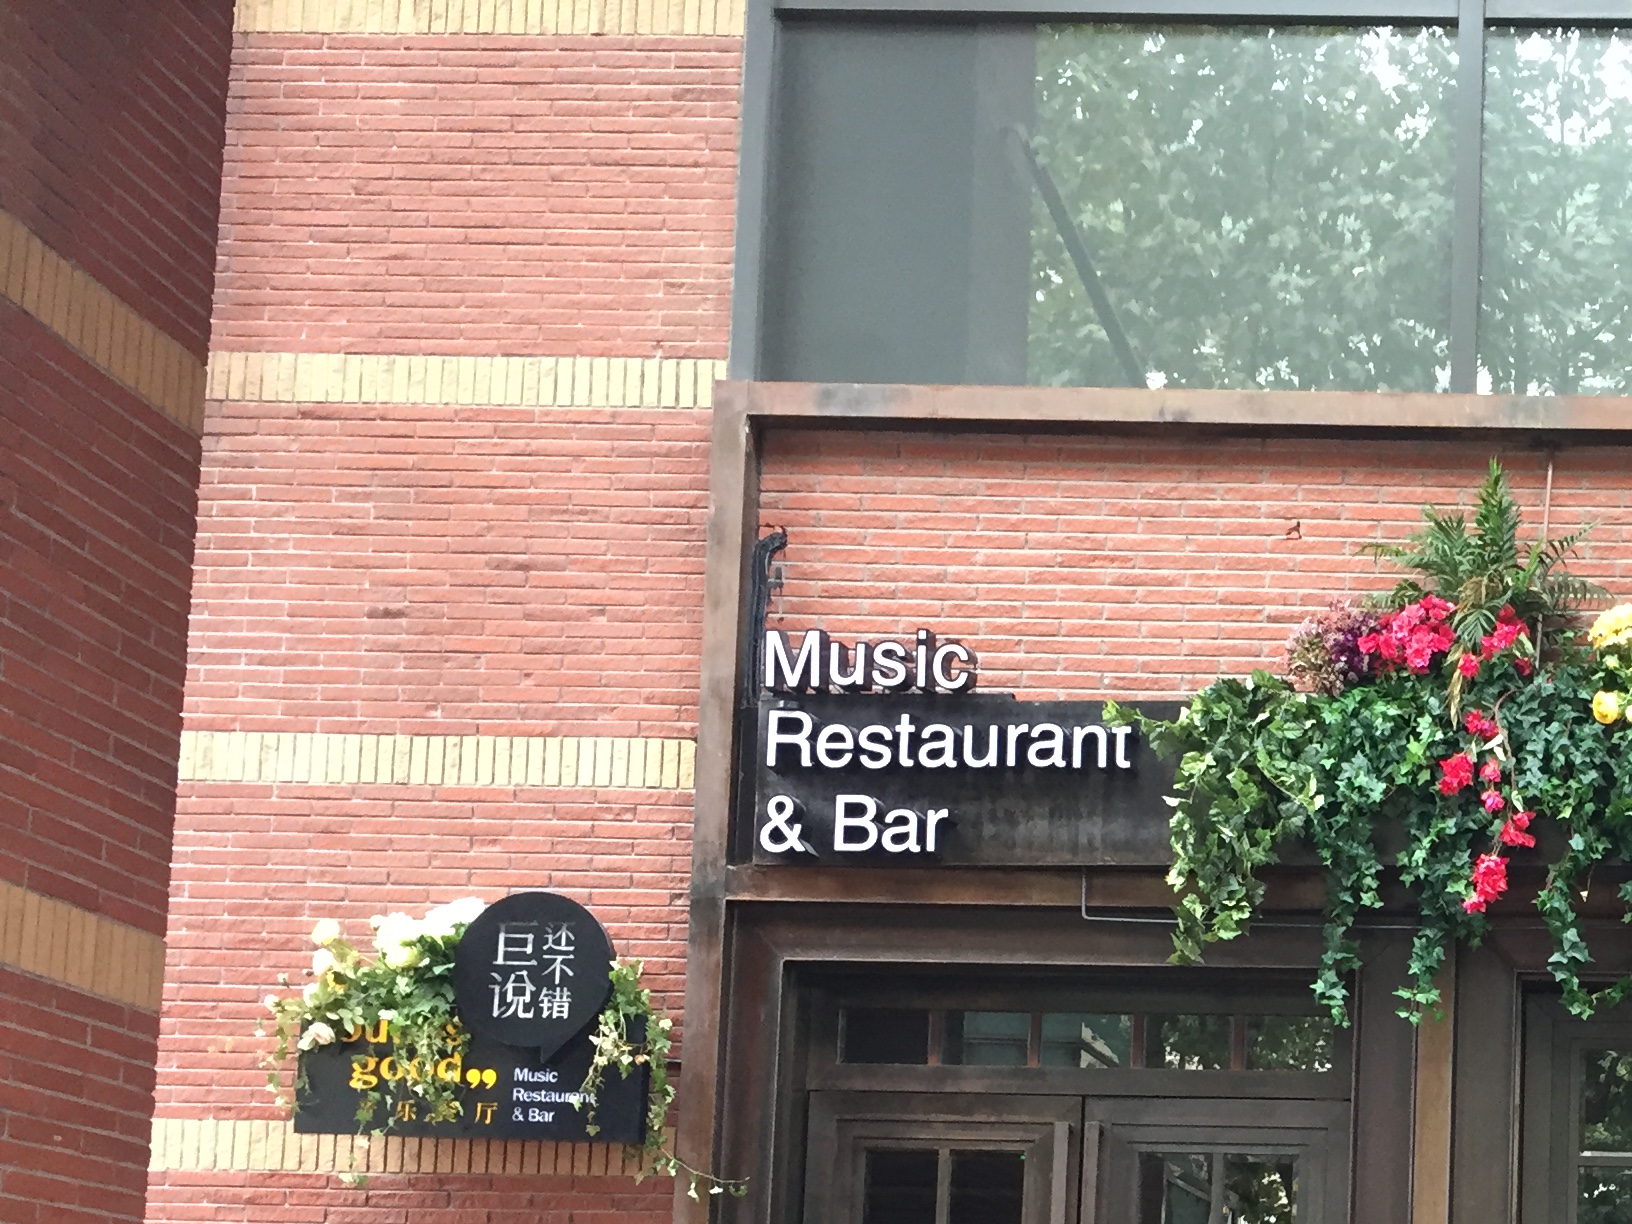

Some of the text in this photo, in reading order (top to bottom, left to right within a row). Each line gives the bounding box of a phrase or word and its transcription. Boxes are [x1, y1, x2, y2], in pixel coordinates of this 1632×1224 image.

[764, 629, 971, 690] Music
[766, 709, 1132, 769] Restaurant
[759, 794, 949, 853] & Bar
[513, 1067, 559, 1083] Music
[512, 1106, 555, 1123] & Bar
